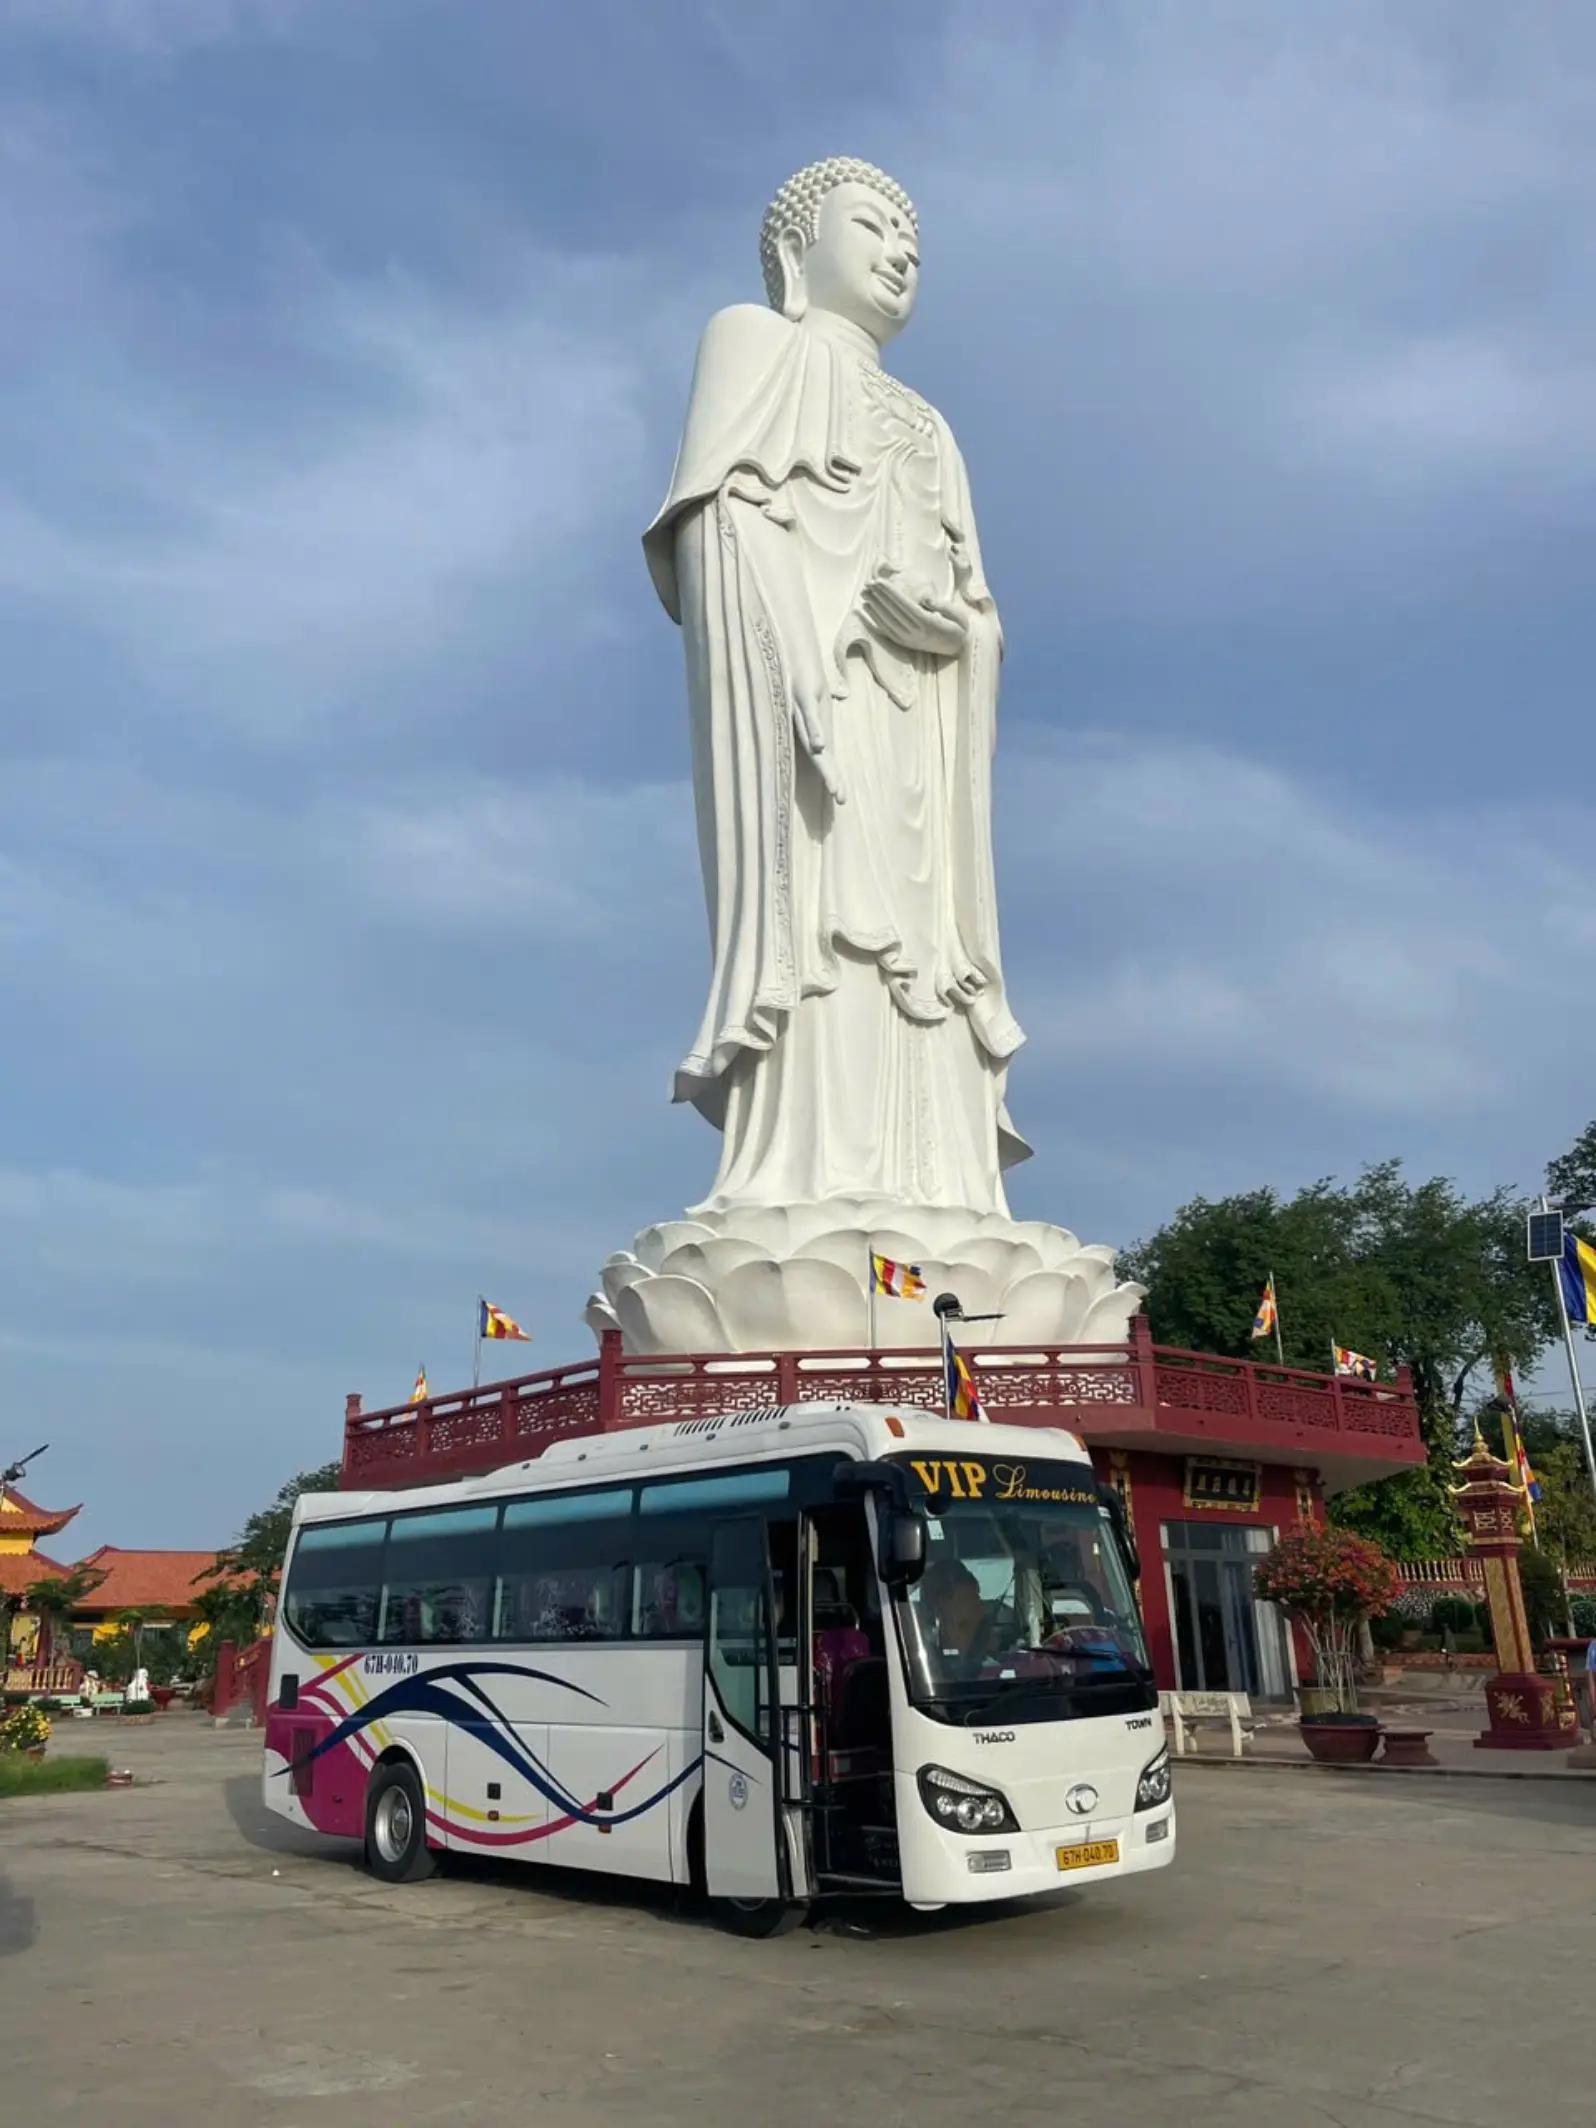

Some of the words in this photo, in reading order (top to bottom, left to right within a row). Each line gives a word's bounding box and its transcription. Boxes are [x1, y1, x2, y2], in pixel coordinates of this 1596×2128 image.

[910, 1461, 987, 1498] VIP
[992, 1463, 1097, 1504] Limousine
[1125, 1717, 1152, 1730] TOWN
[972, 1730, 1016, 1744] THACO
